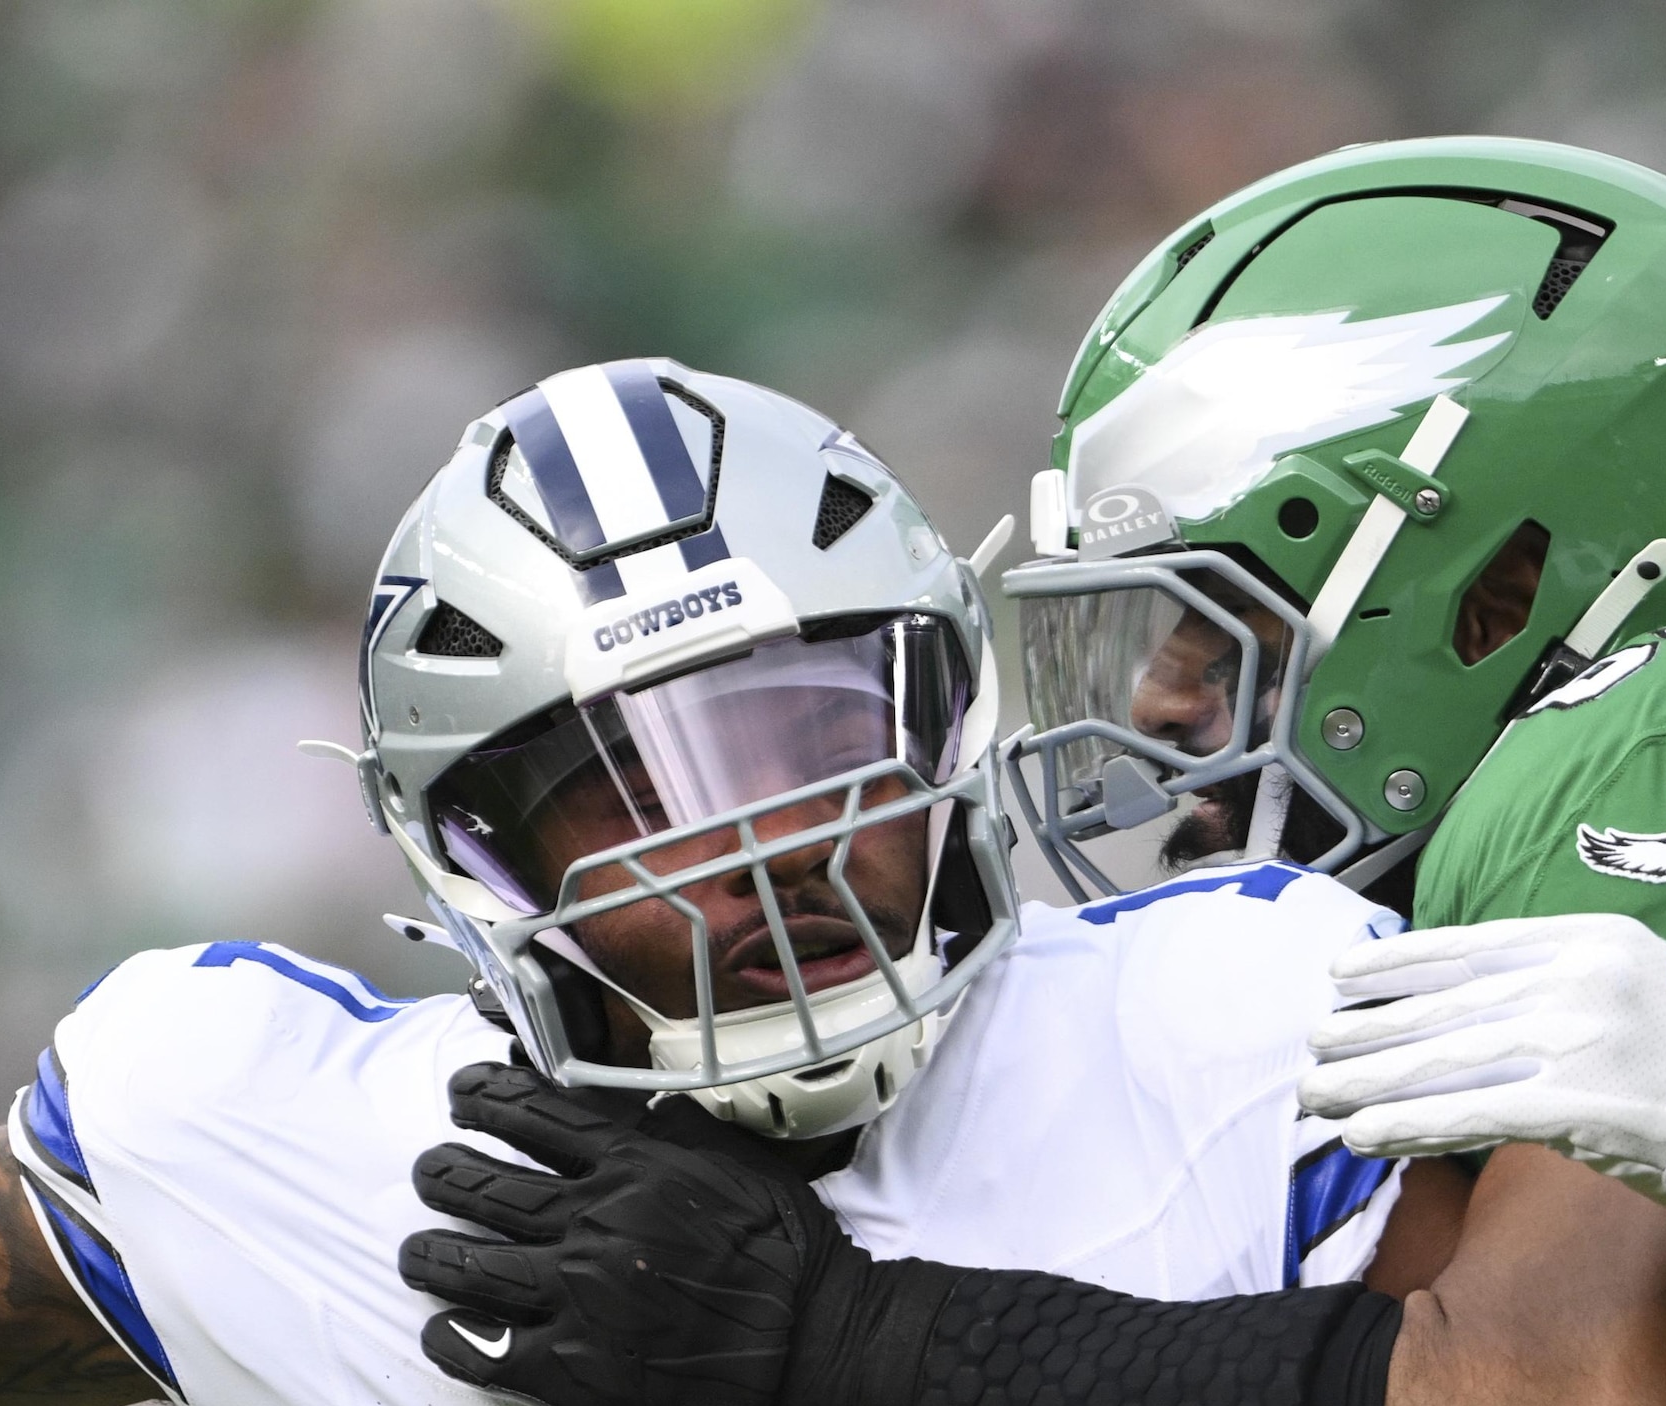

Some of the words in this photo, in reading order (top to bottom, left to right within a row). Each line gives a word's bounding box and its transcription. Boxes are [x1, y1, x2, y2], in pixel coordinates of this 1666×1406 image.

[1363, 462, 1413, 504] Riddell
[1083, 512, 1160, 544] OAKLEY
[593, 580, 743, 652] COWBOYS
